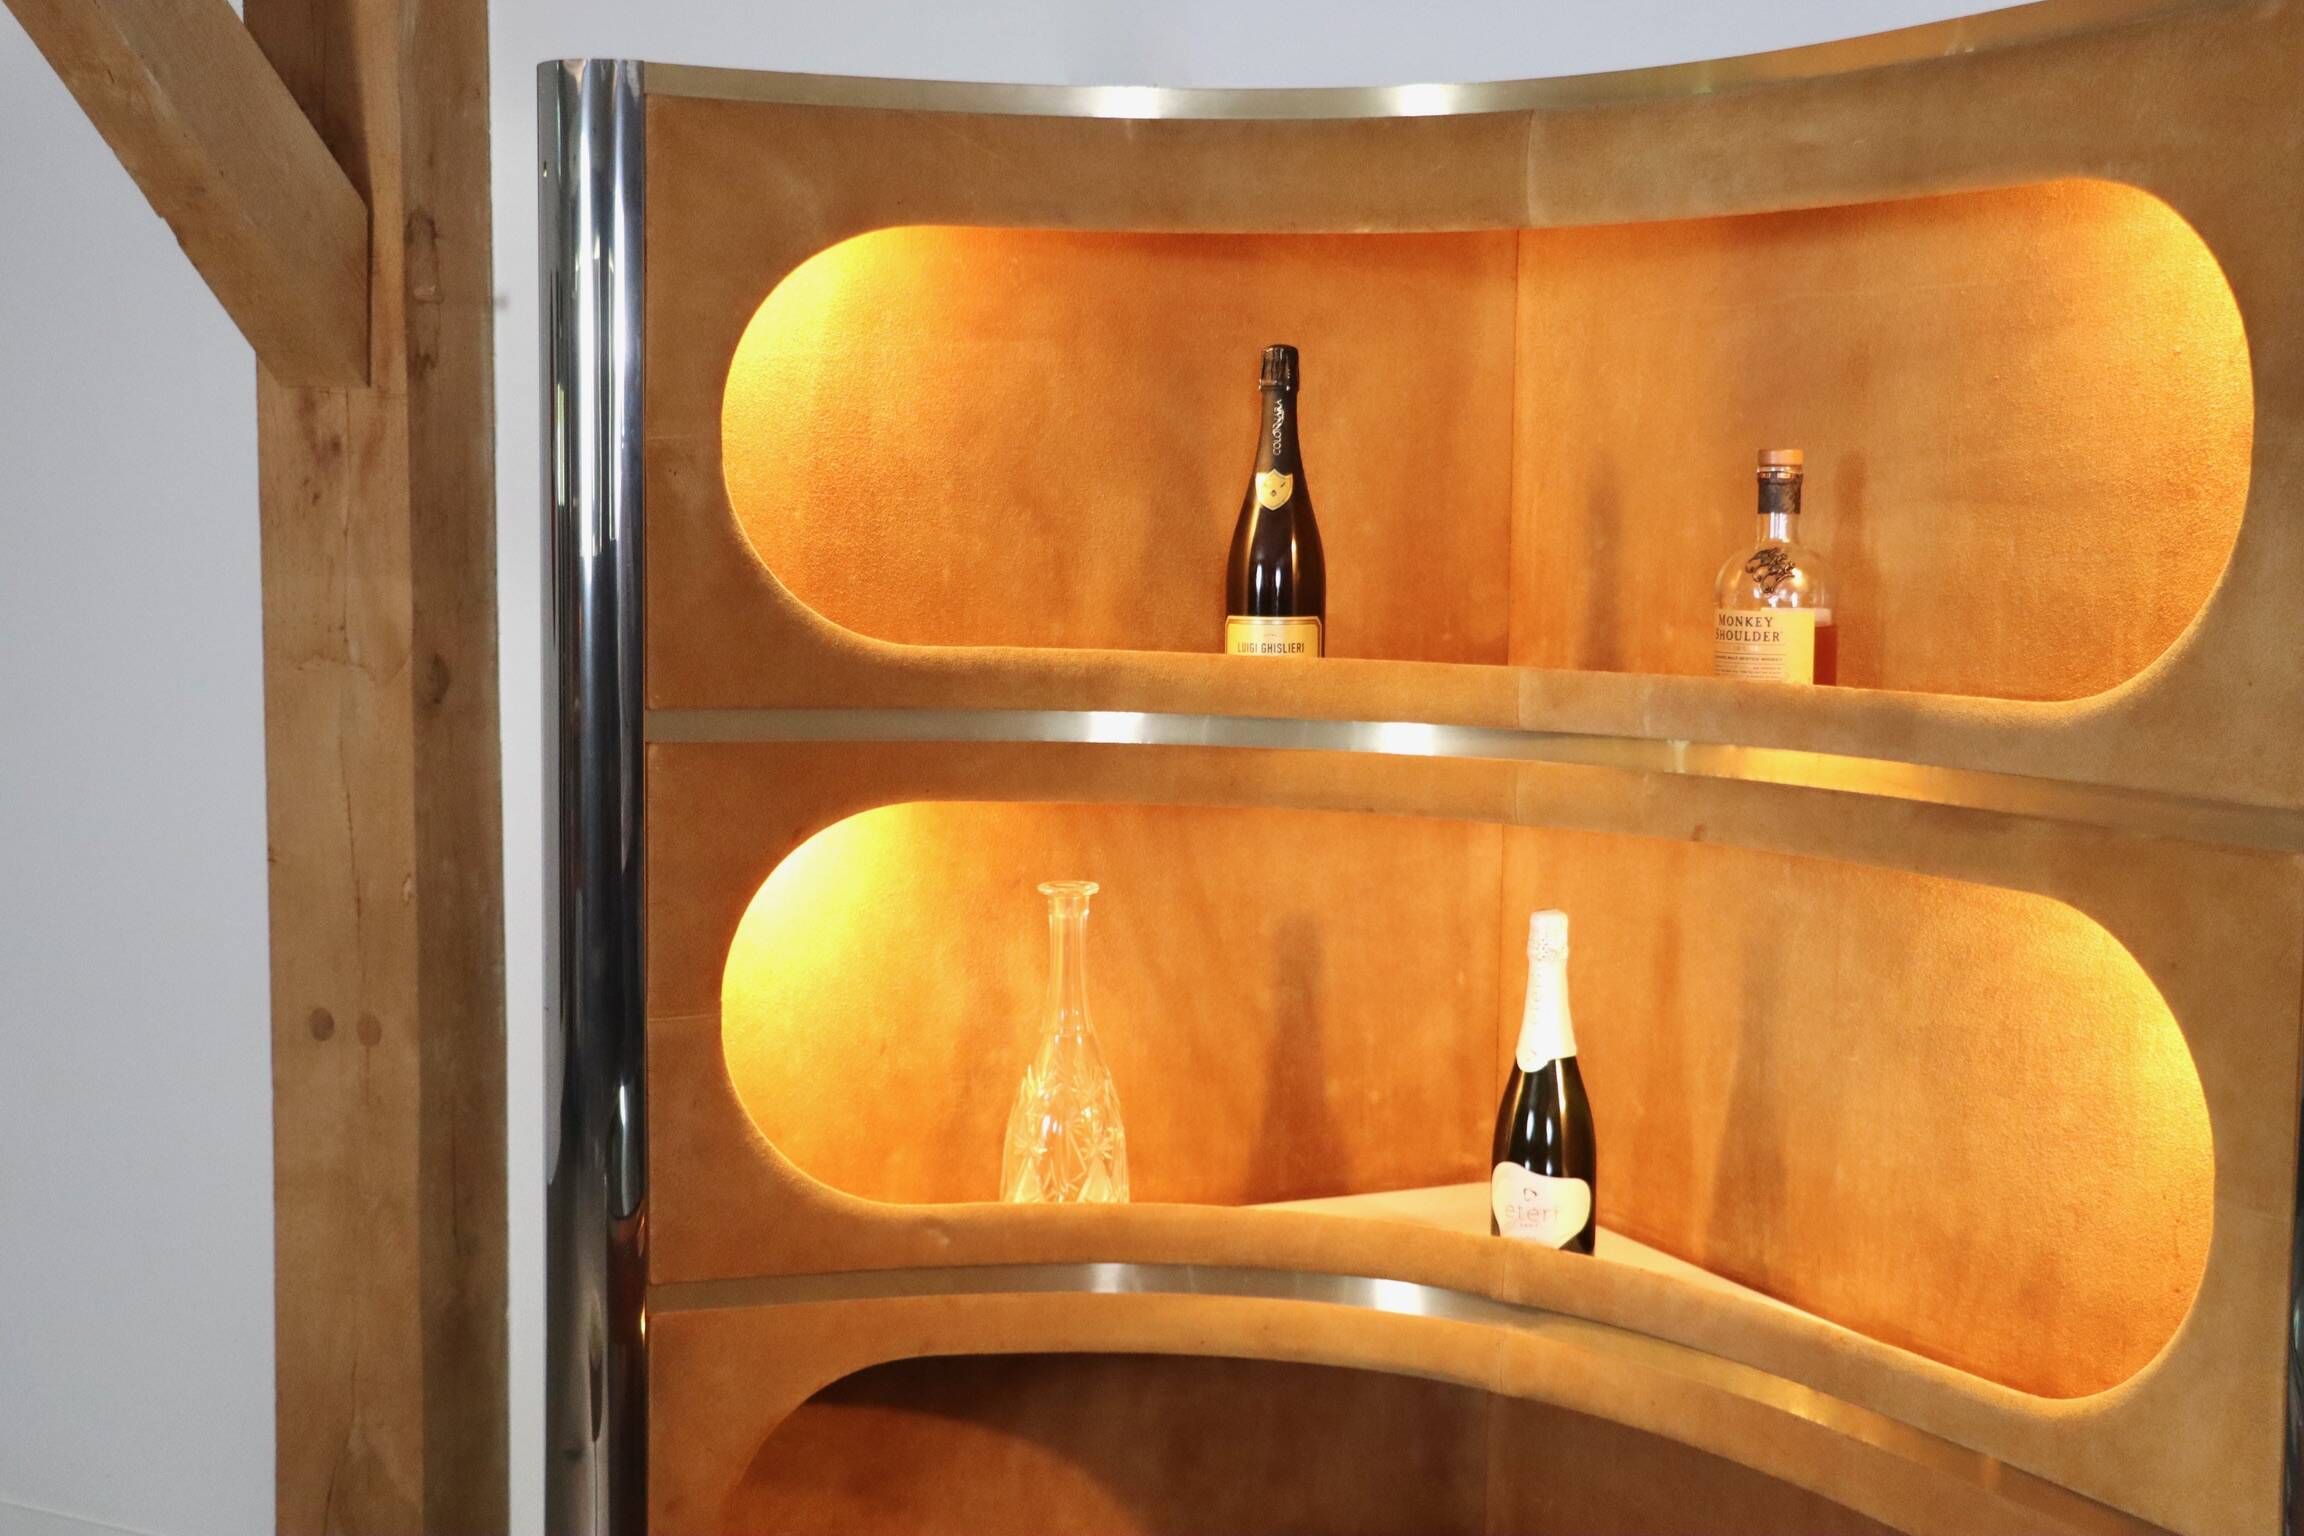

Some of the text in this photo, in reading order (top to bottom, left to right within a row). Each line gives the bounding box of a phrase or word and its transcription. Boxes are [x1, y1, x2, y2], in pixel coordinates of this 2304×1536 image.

[1718, 614, 1773, 628] MONKEY
[1715, 627, 1780, 642] SHOULDER
[1237, 642, 1304, 654] LUIGI GHISLIERI
